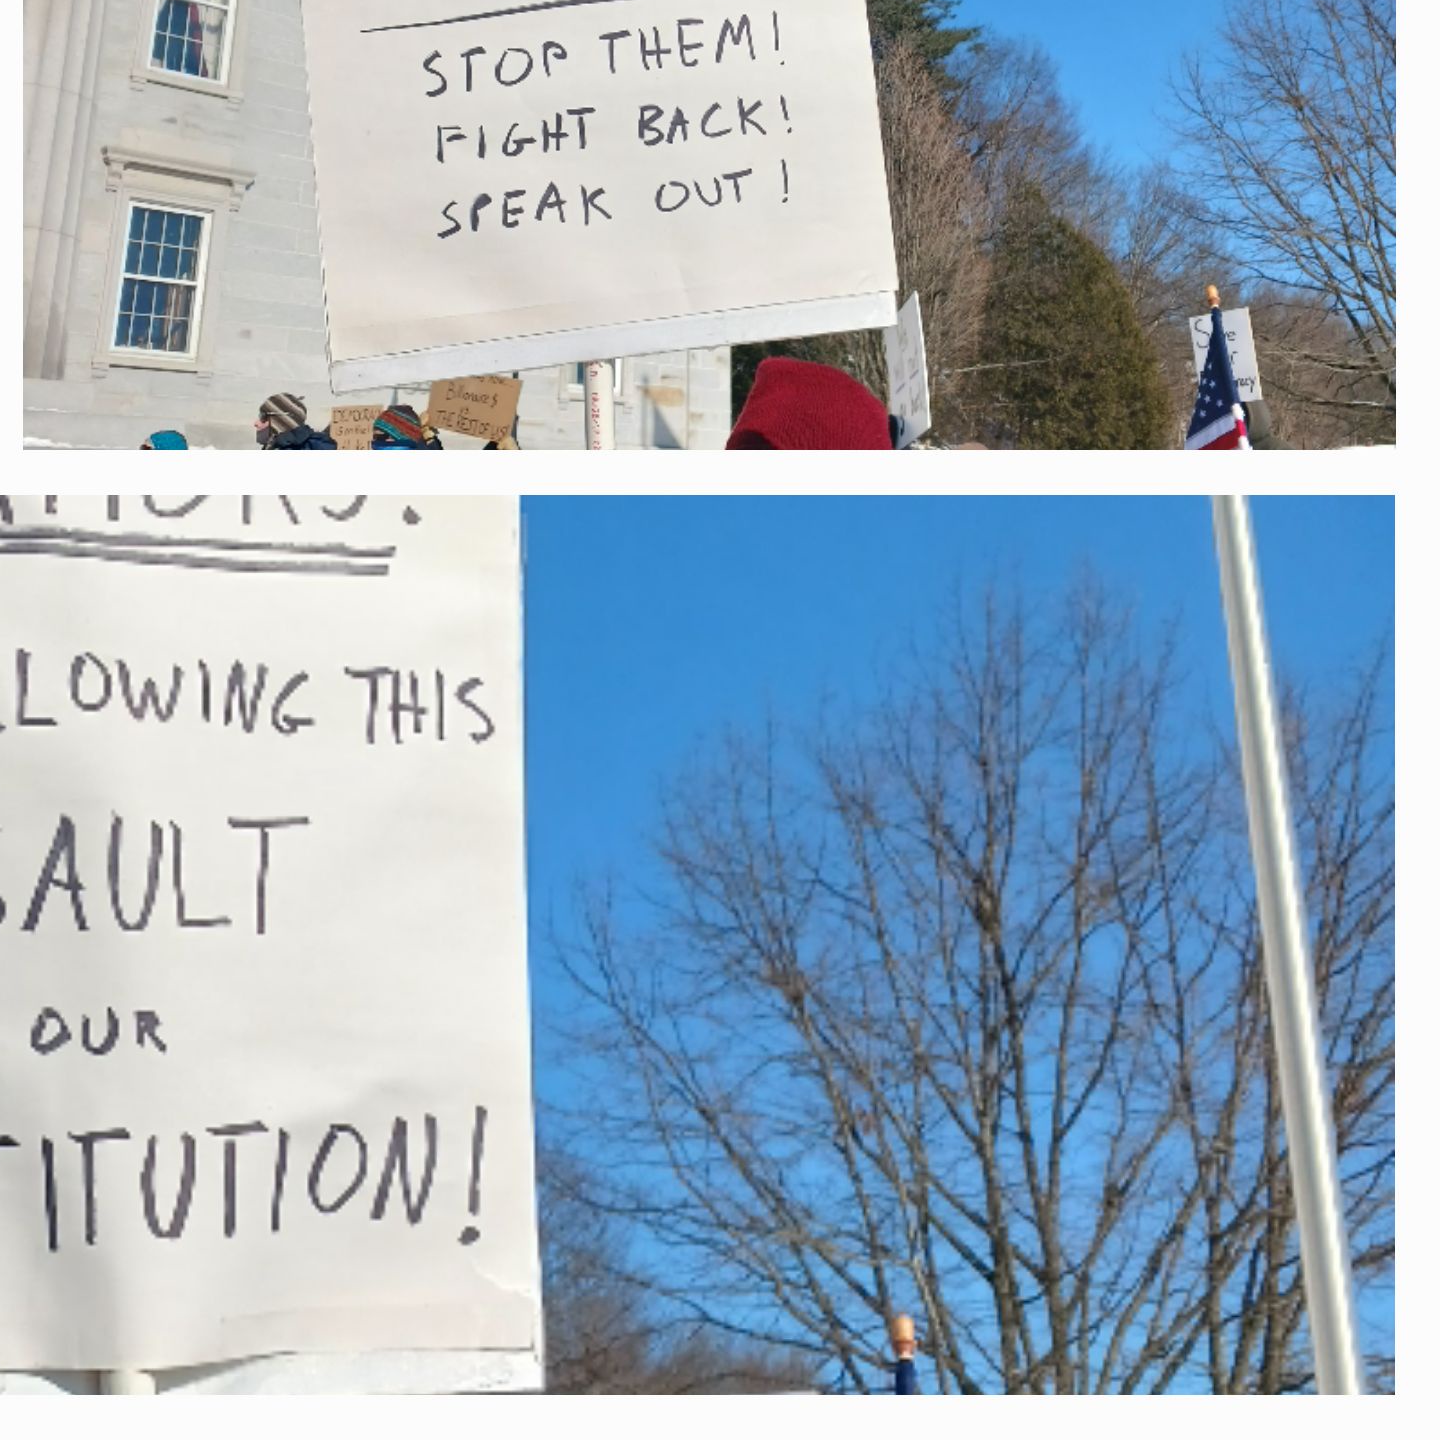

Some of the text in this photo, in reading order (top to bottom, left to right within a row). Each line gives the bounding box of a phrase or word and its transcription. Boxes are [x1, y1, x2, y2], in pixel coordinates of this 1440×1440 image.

[422, 10, 786, 97] STOP THEM!
[436, 95, 794, 164] FIGHT BACK!
[436, 181, 613, 239] SPEAK
[344, 664, 497, 744] THIS
[29, 1005, 169, 1055] OUR
